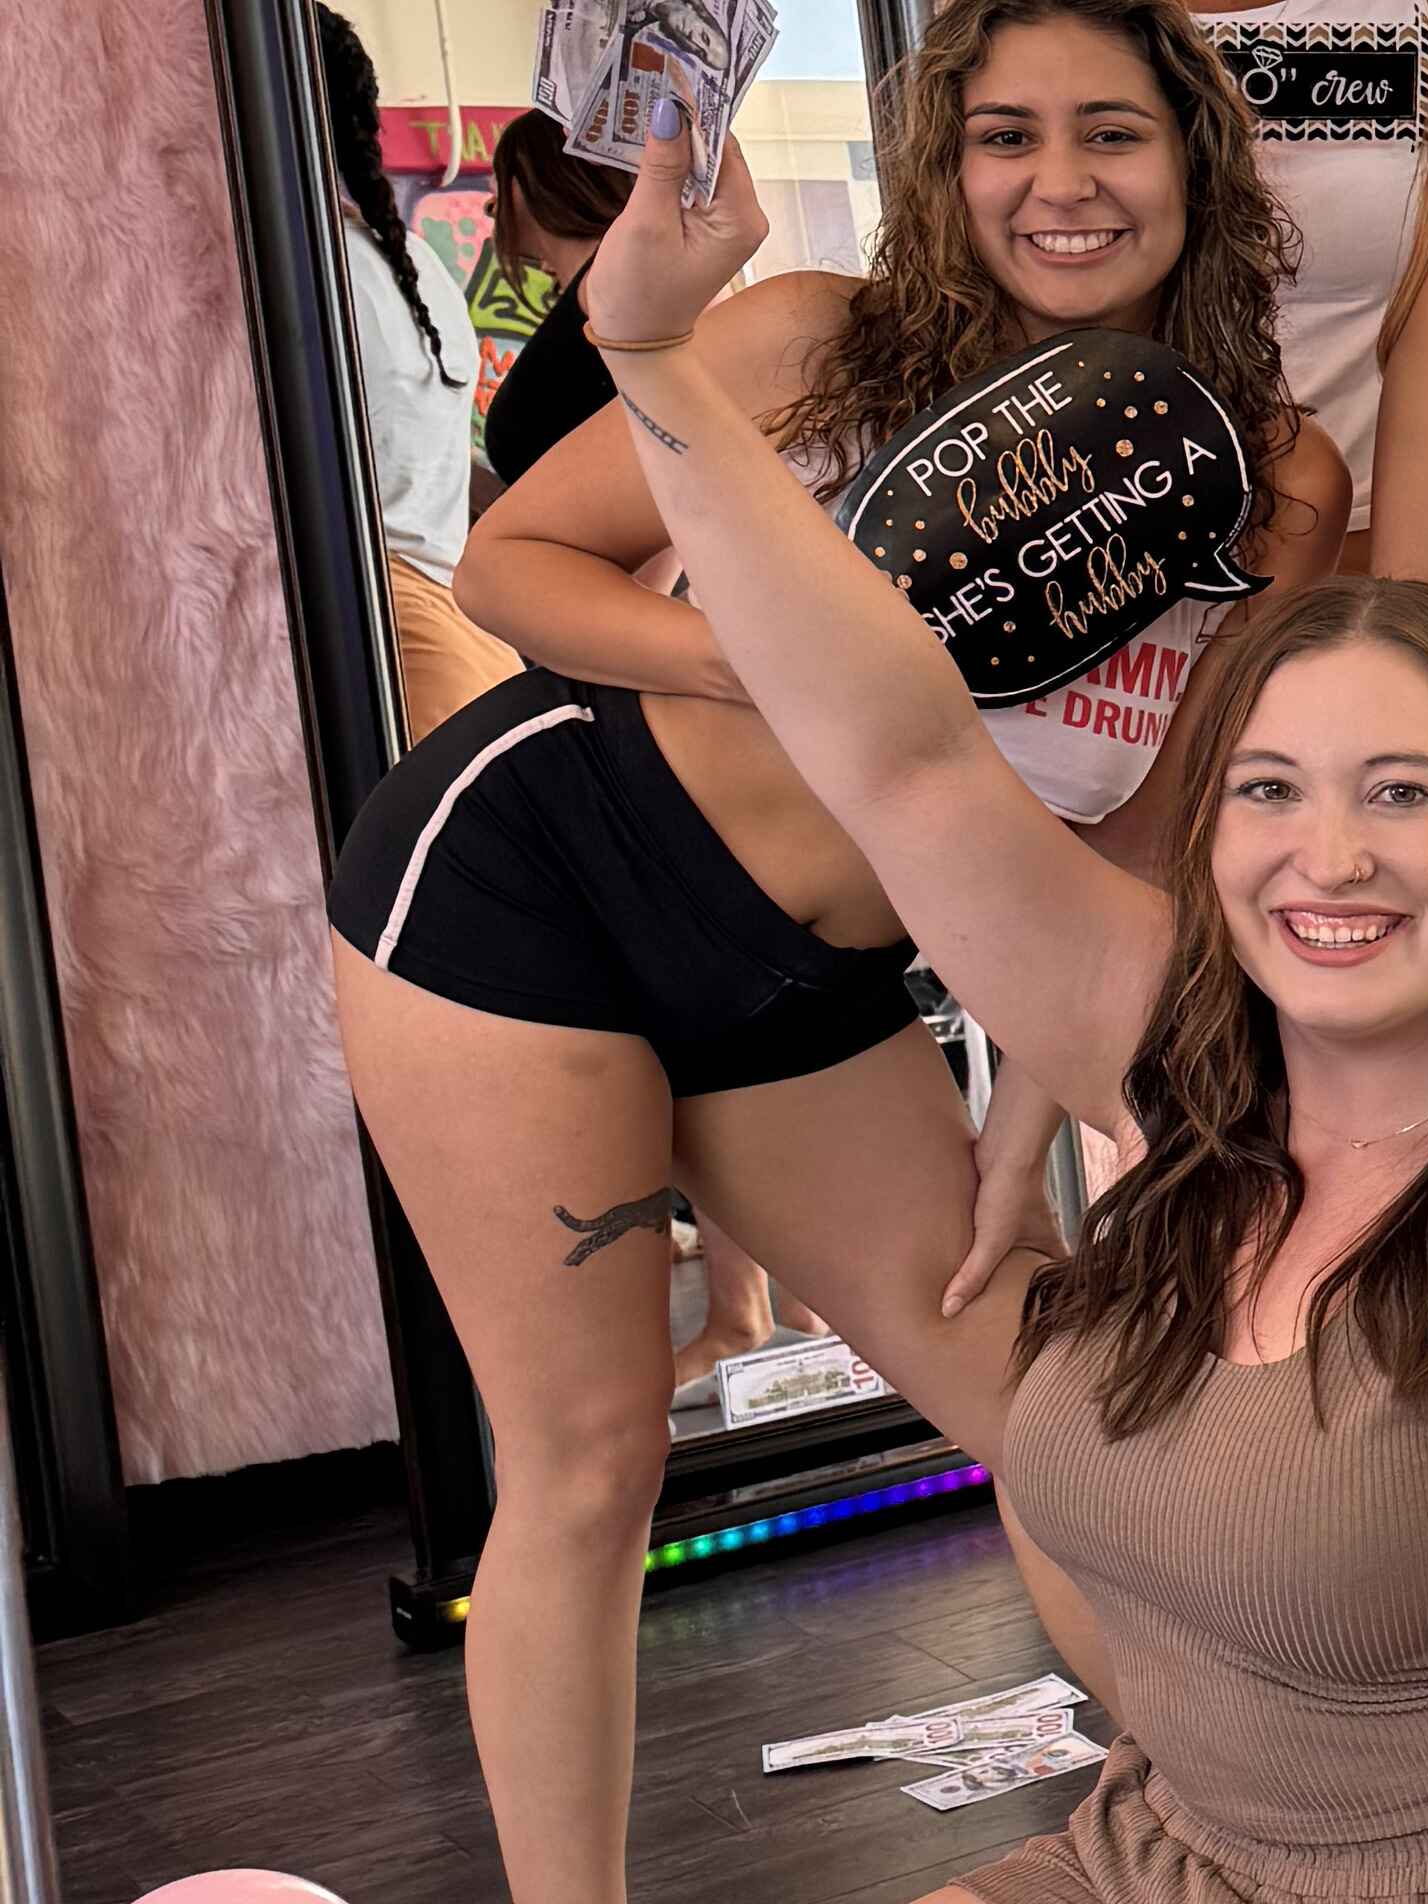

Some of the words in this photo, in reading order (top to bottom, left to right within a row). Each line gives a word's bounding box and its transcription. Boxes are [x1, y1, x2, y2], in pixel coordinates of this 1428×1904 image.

[907, 422, 989, 496] POP
[992, 371, 1072, 434] THE
[956, 429, 1093, 544] bubbly
[921, 568, 1015, 646] SHE'S
[1018, 459, 1172, 578] GETTING
[1182, 436, 1217, 475] A
[1046, 533, 1166, 639] hubby
[852, 1356, 875, 1388] 10
